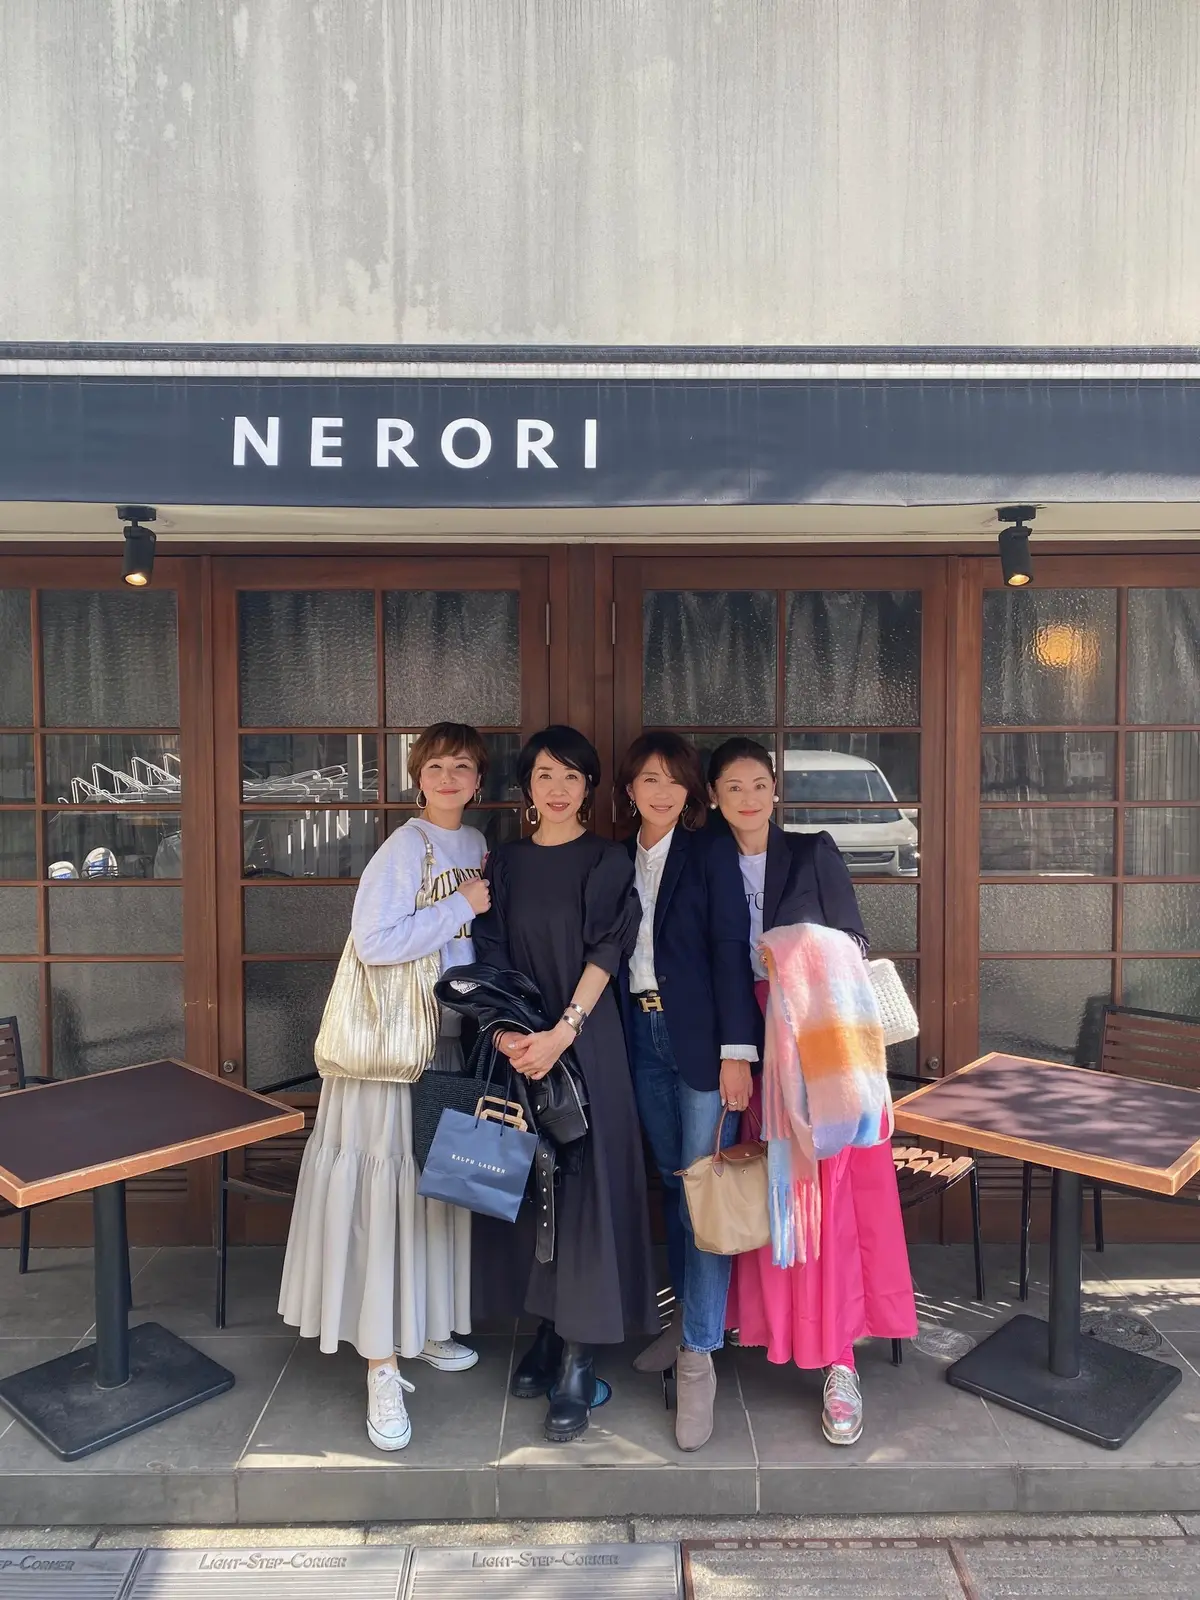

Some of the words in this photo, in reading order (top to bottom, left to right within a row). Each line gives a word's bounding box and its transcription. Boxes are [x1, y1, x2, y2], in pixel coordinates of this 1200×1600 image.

[232, 416, 598, 469] NERORI
[451, 1153, 475, 1165] RALPH
[478, 1161, 506, 1174] LAUREN
